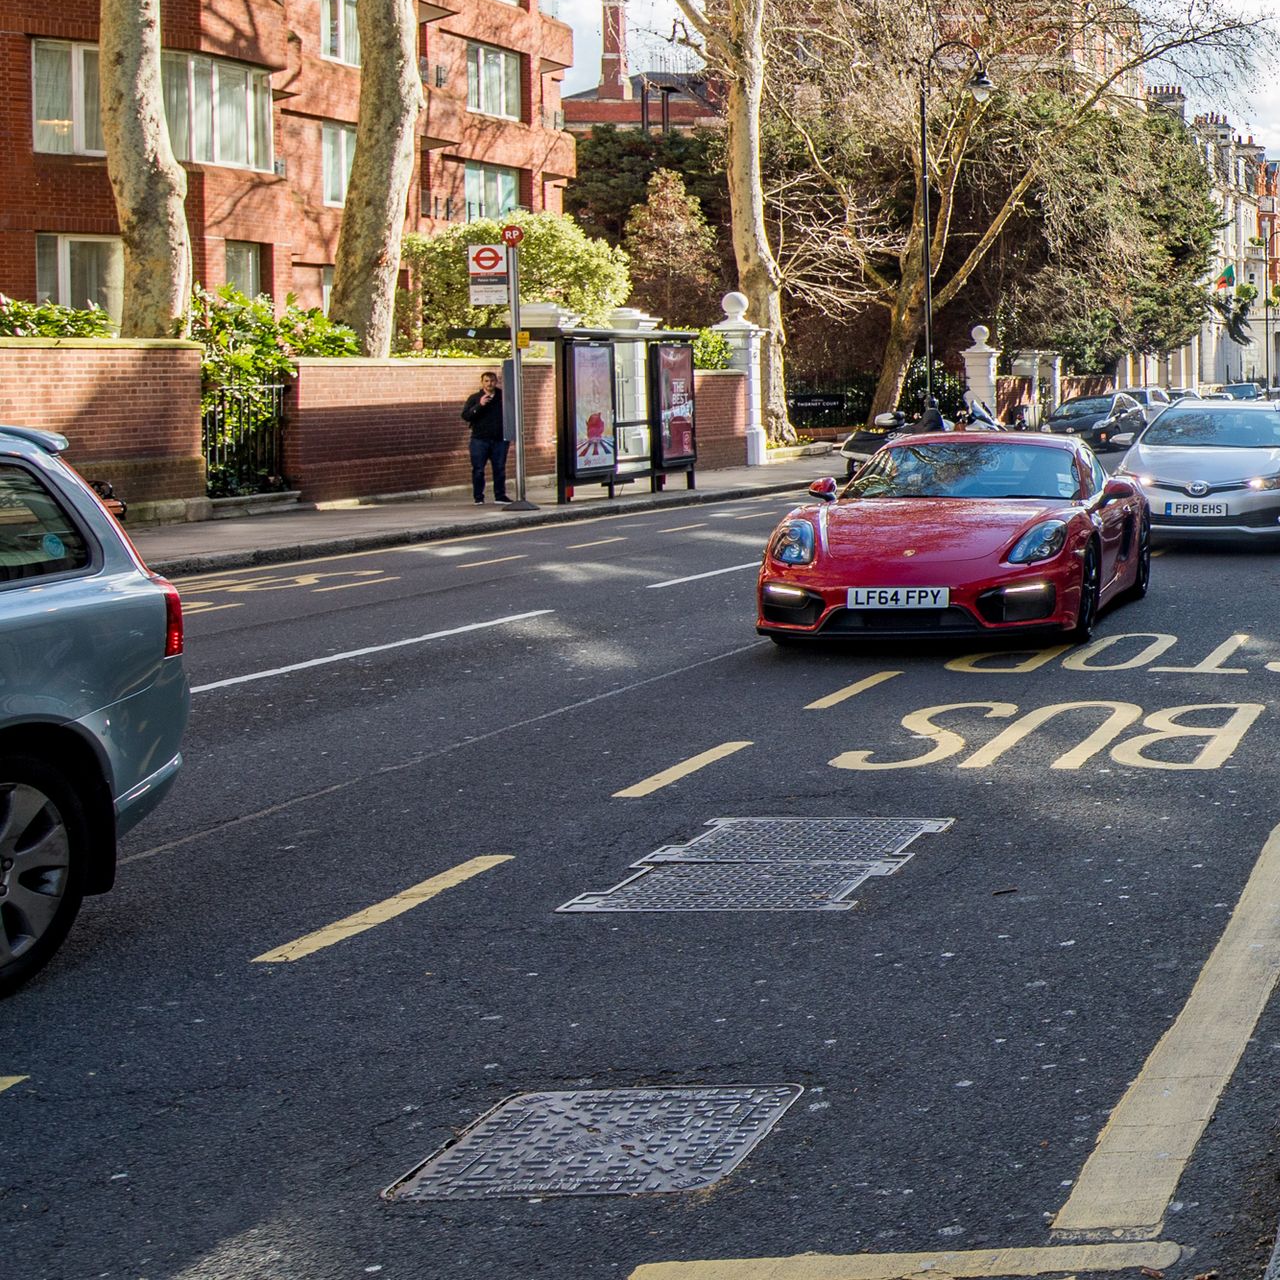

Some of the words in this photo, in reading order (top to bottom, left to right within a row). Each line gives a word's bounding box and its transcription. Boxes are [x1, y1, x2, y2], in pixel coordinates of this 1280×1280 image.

[505, 230, 519, 239] RP
[672, 382, 685, 392] THE
[672, 394, 688, 405] BEST
[1176, 504, 1199, 513] FP18
[1202, 504, 1222, 514] EHS
[854, 590, 900, 605] LF64
[906, 590, 940, 604] FPY
[827, 700, 1266, 771] BUS
